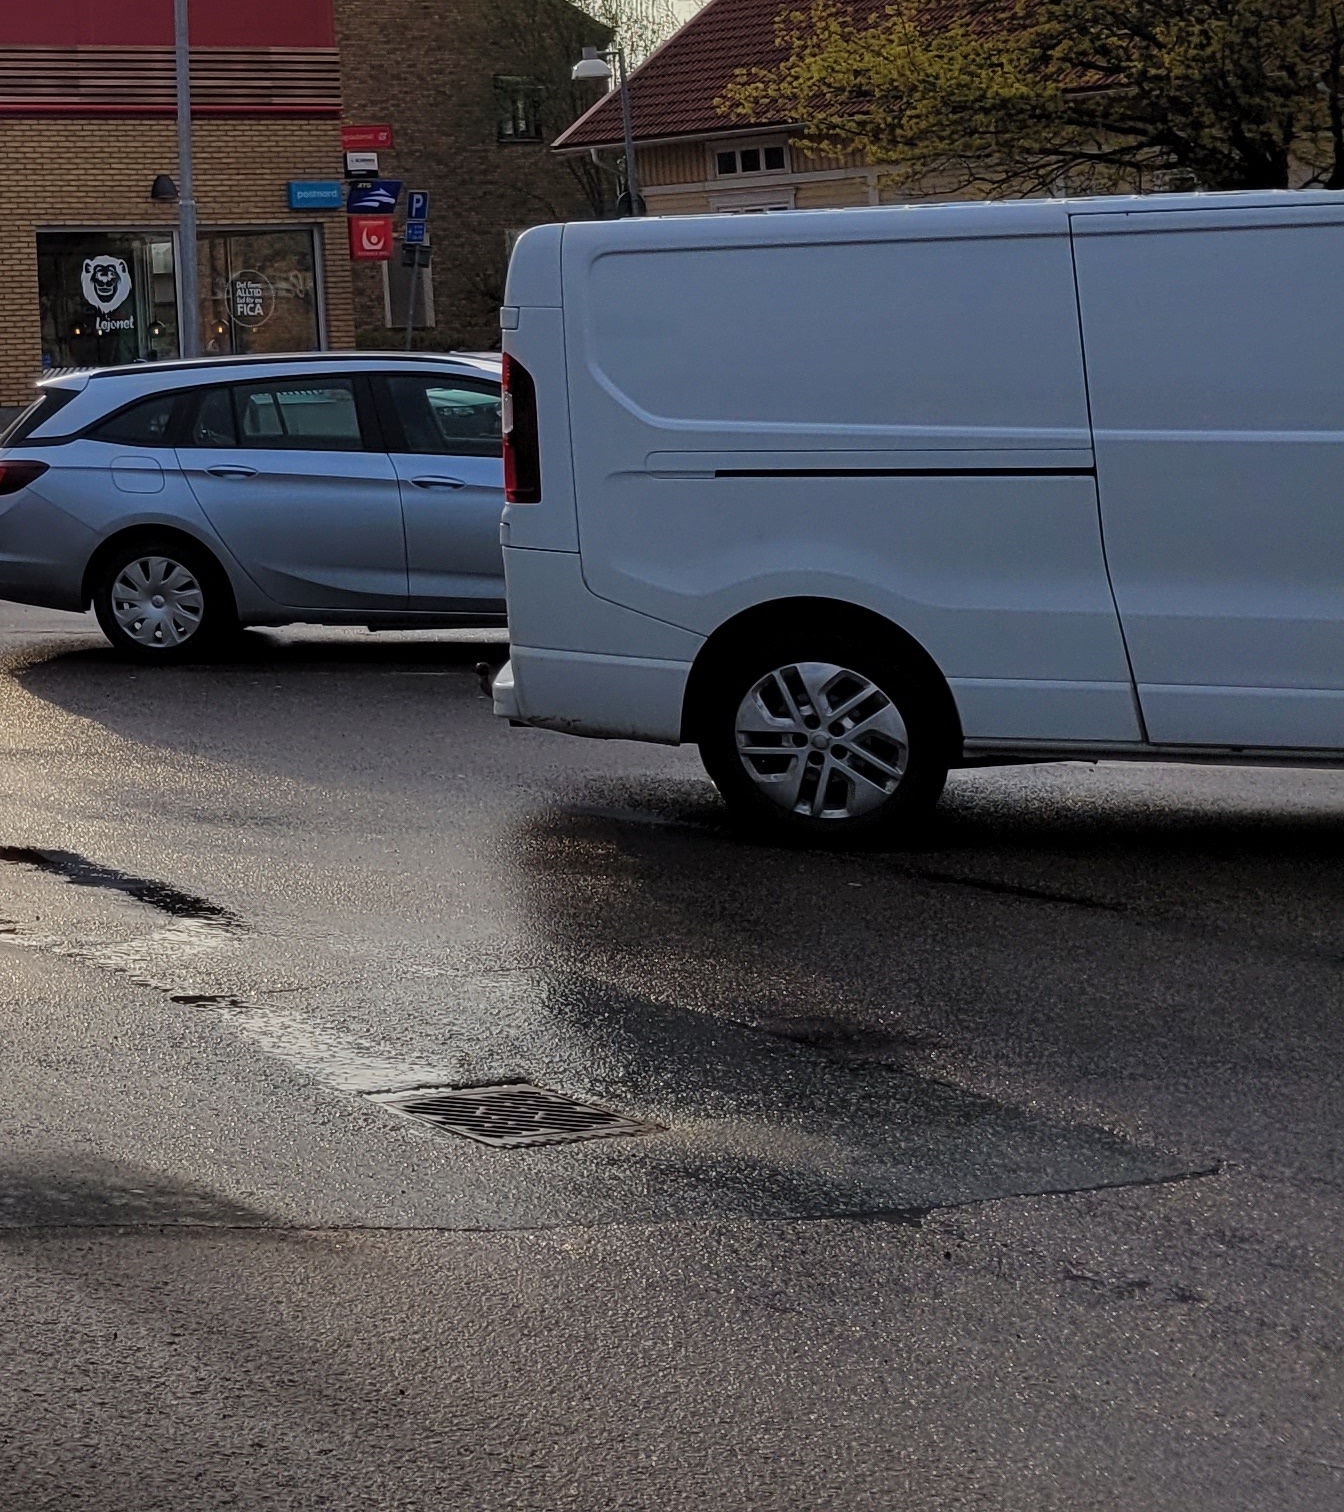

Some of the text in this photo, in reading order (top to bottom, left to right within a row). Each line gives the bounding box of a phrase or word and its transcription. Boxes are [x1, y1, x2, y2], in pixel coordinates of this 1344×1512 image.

[412, 193, 424, 218] P
[236, 288, 263, 296] ALLTID
[237, 303, 264, 316] FICA
[95, 315, 135, 332] Lejonet
